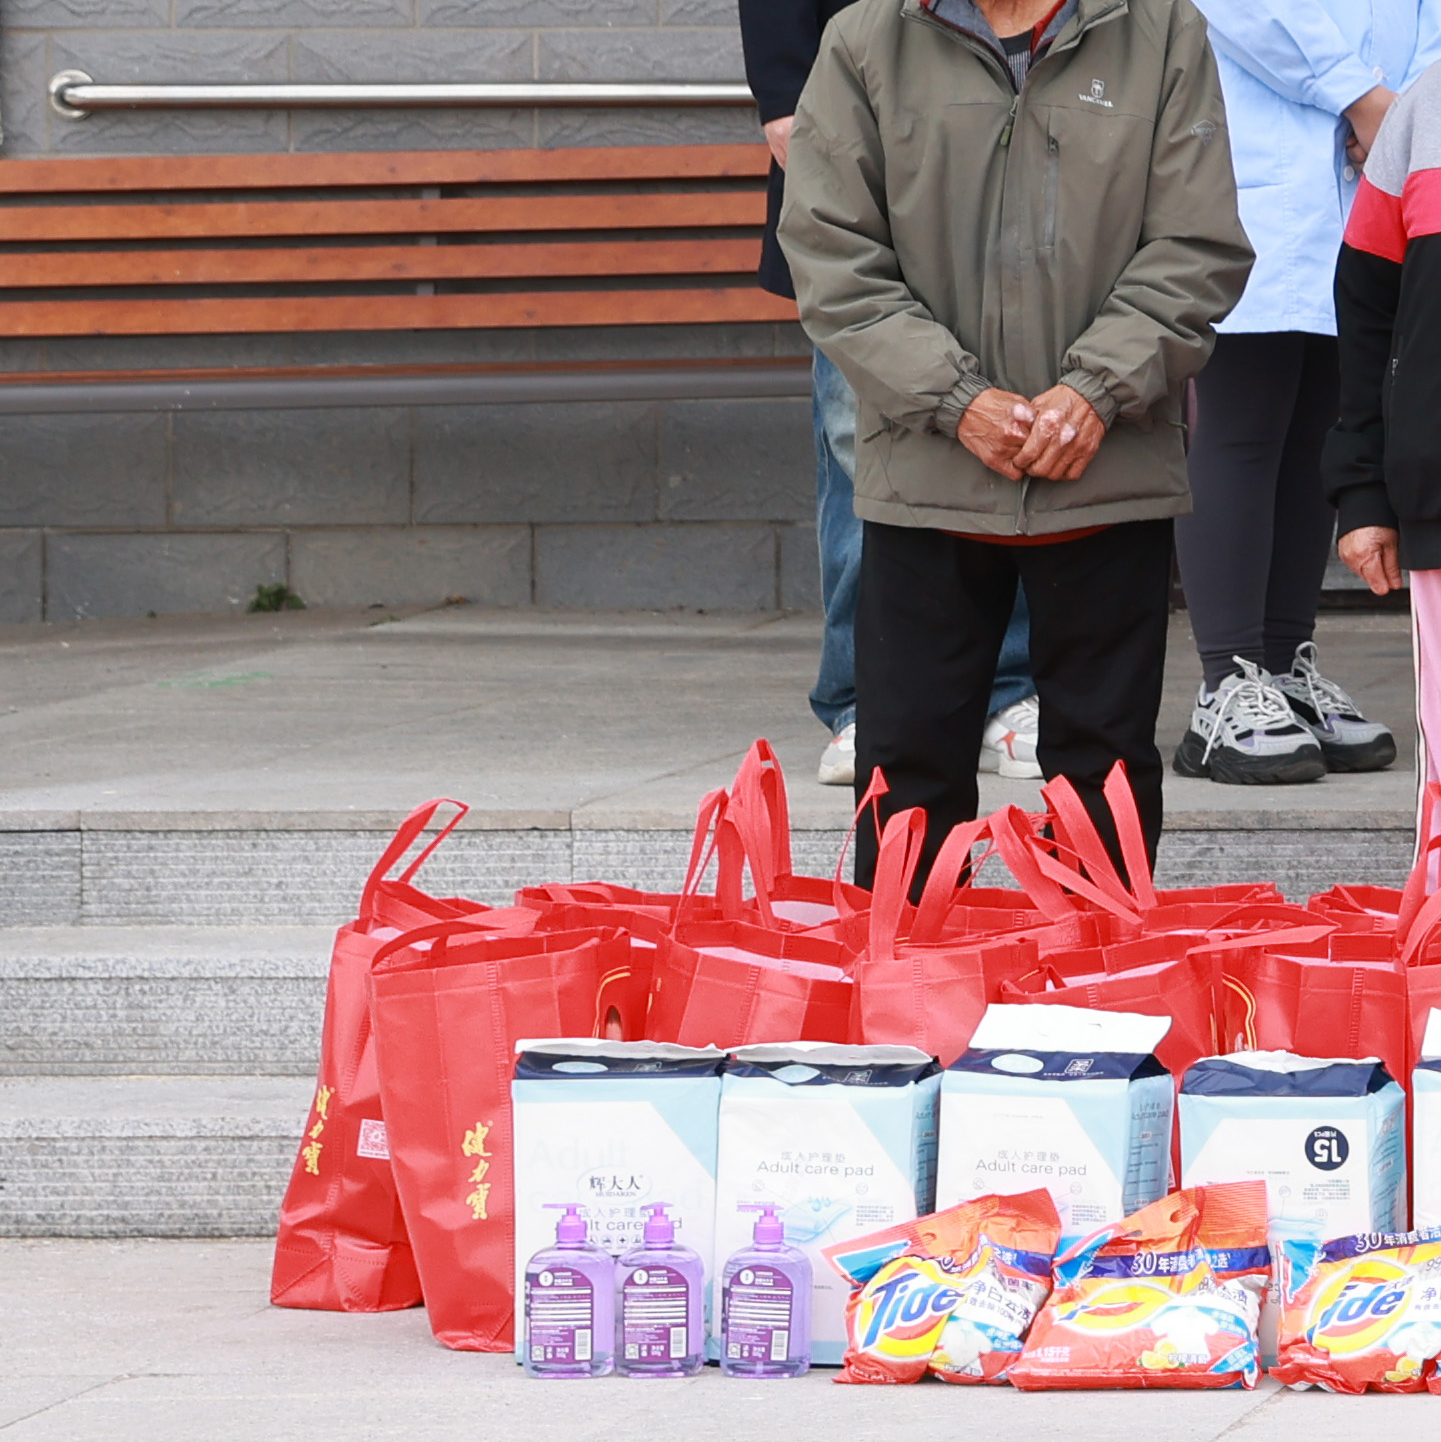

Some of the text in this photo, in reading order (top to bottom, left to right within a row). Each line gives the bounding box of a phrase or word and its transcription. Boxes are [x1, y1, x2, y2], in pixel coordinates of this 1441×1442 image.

[1314, 1138, 1342, 1163] 15
[757, 1160, 874, 1178] Adult care pad
[976, 1159, 1087, 1177] Adult care pad
[606, 1219, 643, 1231] care
[1310, 1284, 1405, 1336] ide
